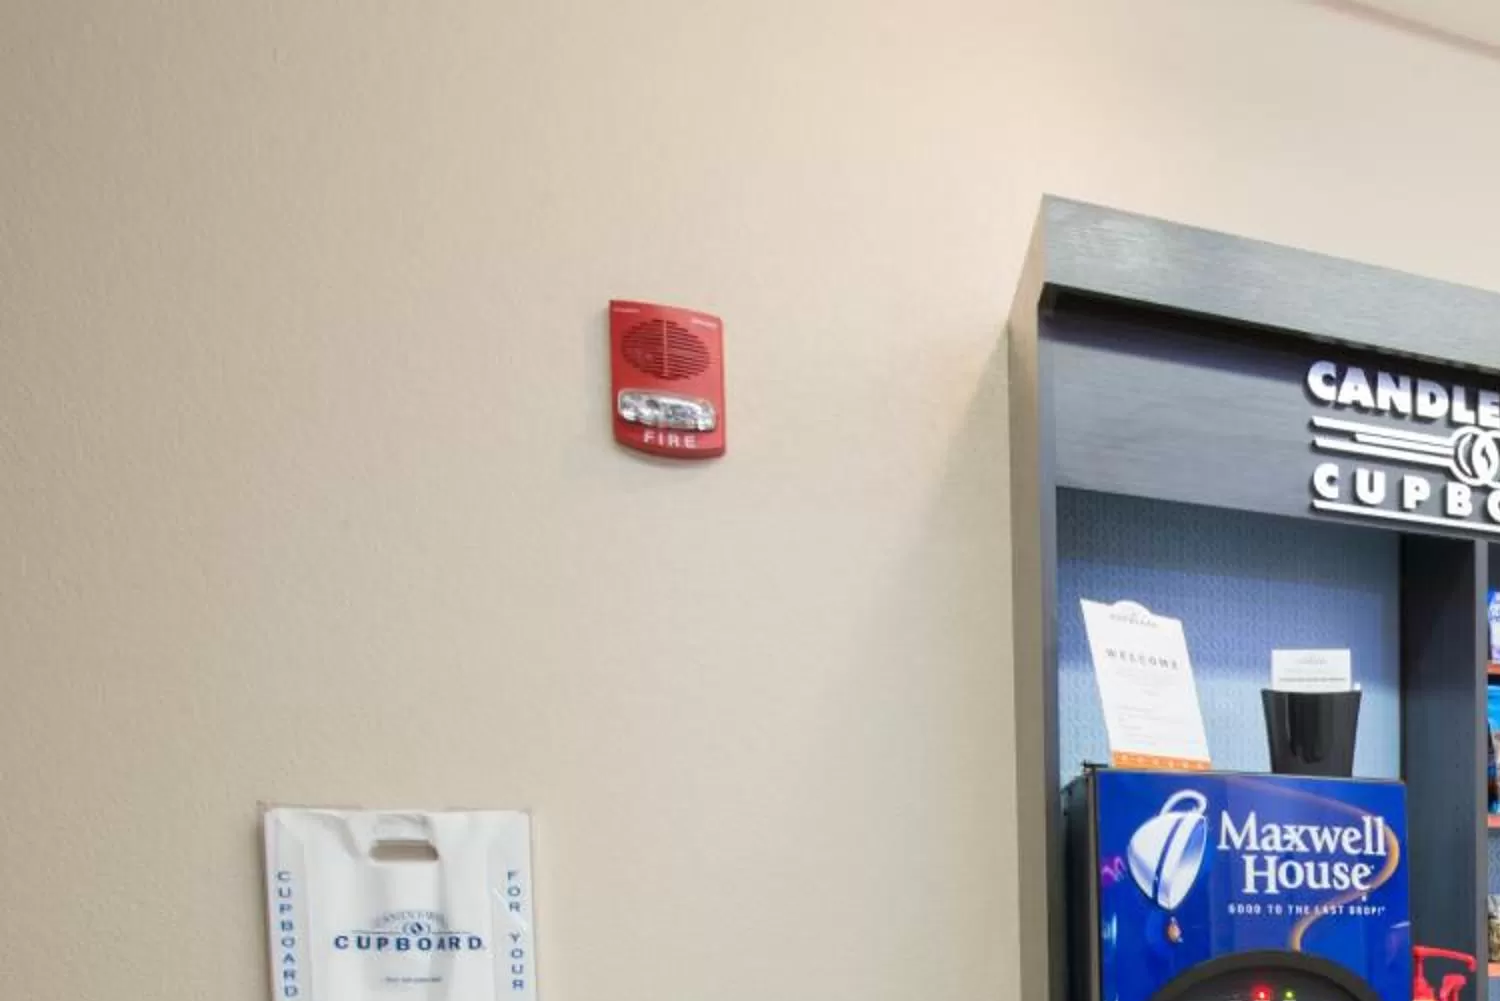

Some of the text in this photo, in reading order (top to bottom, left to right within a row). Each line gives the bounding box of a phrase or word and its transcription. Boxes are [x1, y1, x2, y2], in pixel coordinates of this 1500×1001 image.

[643, 429, 698, 449] FIRE
[1105, 647, 1178, 670] WELCOME
[1217, 810, 1388, 856] Maxwell
[507, 871, 521, 913] FOR
[1242, 855, 1373, 894] House
[1228, 904, 1262, 915] GOOD
[1267, 904, 1283, 915] TO
[1288, 904, 1310, 915] THE
[1313, 904, 1345, 916] LAST
[277, 871, 299, 998] CUPBOARD
[334, 935, 483, 951] CUPBOARD
[508, 932, 525, 991] YOUR
